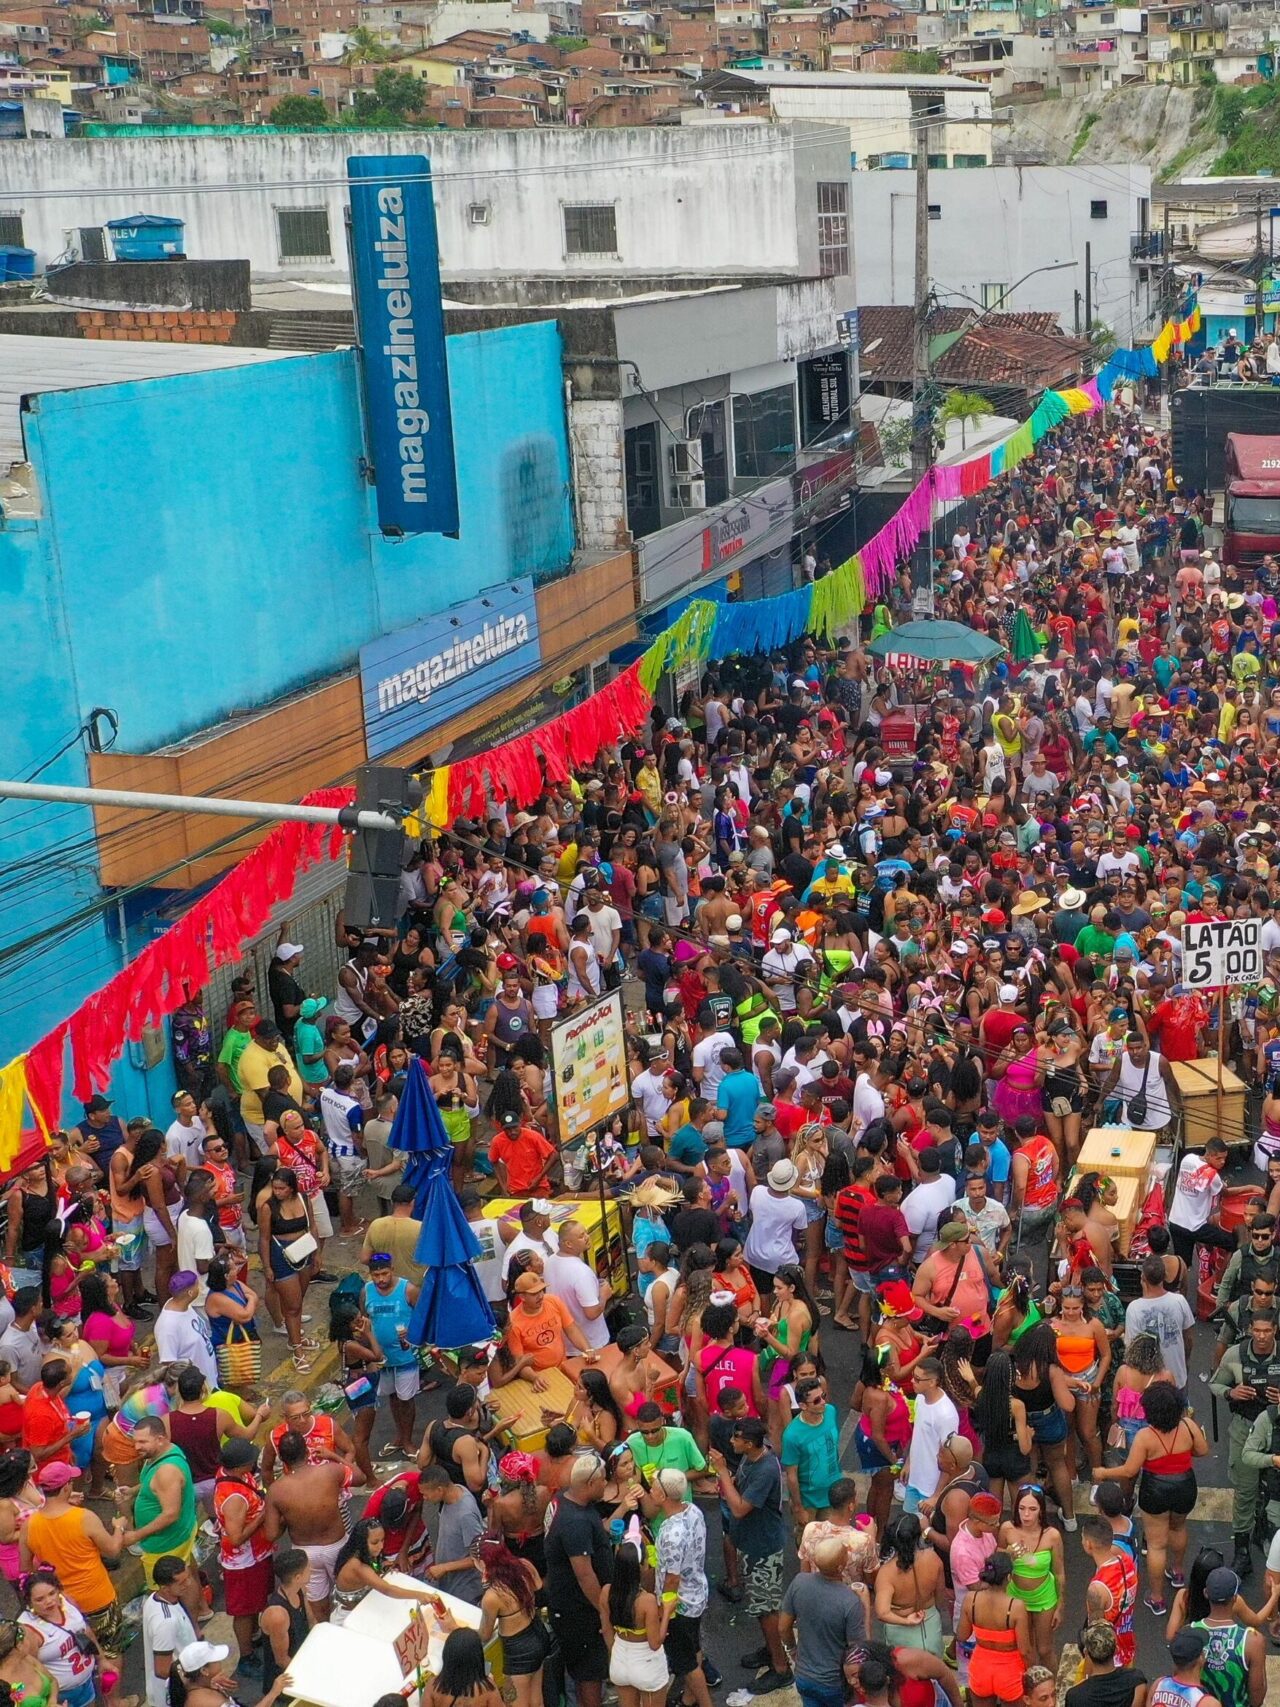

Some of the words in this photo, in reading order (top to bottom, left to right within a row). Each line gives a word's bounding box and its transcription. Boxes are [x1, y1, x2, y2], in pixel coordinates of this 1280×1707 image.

[374, 187, 429, 503] magazineluiza
[1261, 459, 1280, 469] 2192
[378, 613, 529, 714] magazineluiza
[1185, 919, 1257, 951] LATÃO
[1226, 949, 1257, 974] 00
[526, 1317, 558, 1337] GUCCI
